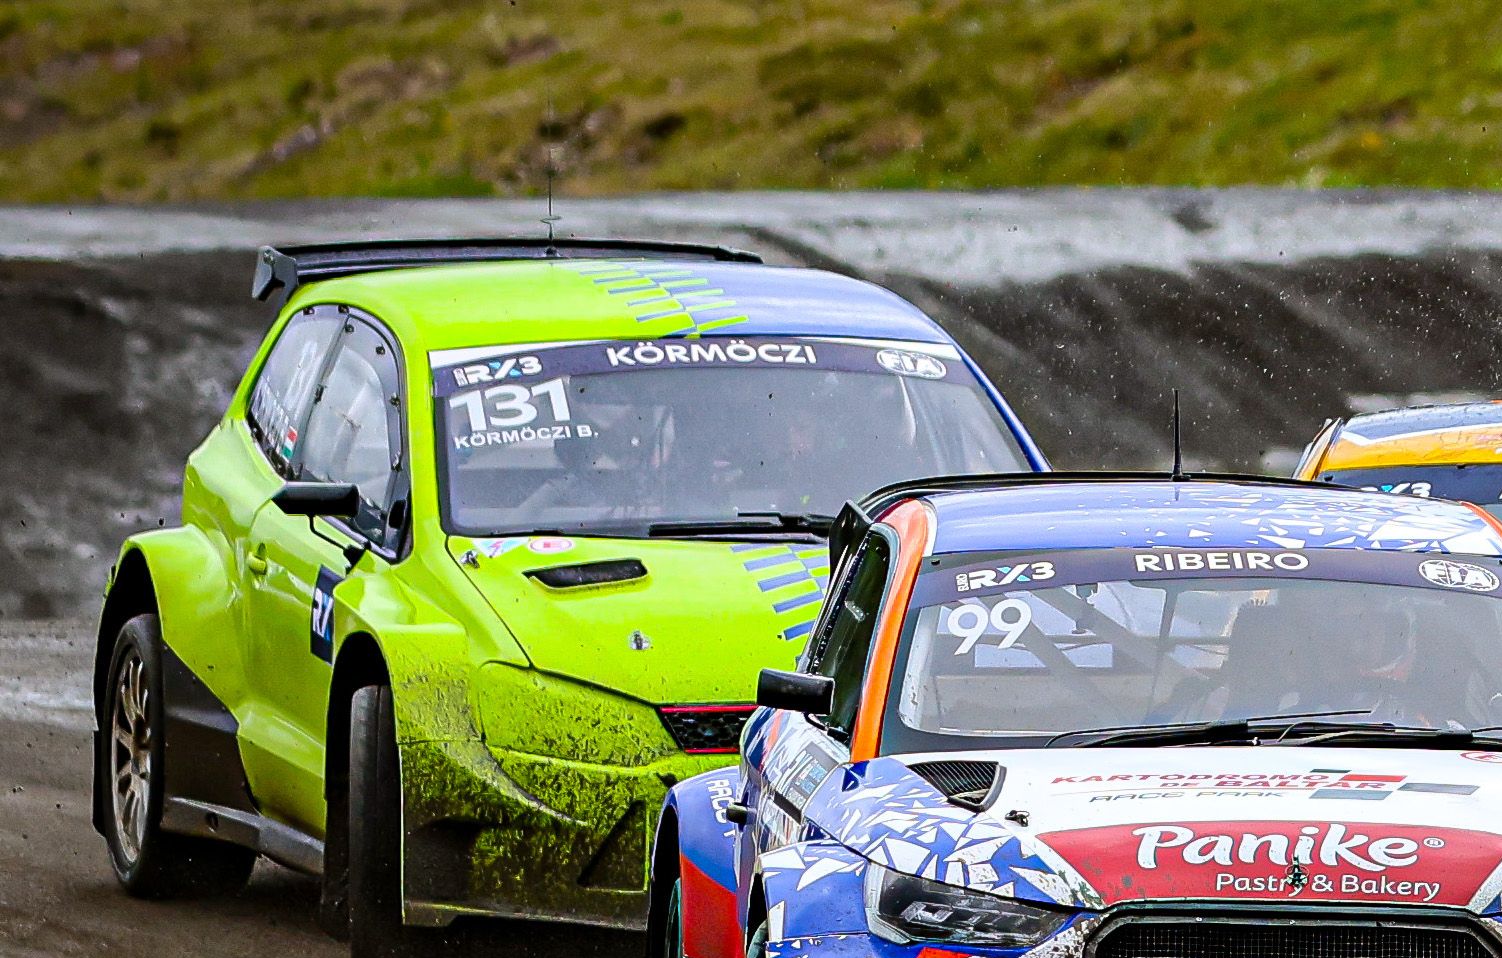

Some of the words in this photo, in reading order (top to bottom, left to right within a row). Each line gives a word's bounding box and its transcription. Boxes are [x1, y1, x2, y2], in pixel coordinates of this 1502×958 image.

[607, 340, 818, 367] KÖRMÖCZI
[879, 350, 944, 379] FIA
[450, 377, 571, 432] 131
[455, 425, 572, 450] KÖRMÖCZI
[576, 424, 599, 439] B.
[970, 562, 1056, 590] RX3
[1135, 552, 1309, 573] RIBEIRO
[1421, 561, 1496, 590] FIA
[947, 598, 1032, 656] 99
[1089, 791, 1186, 803] RACE
[1214, 780, 1387, 789] BALTAR
[1311, 874, 1334, 892] &
[1341, 874, 1440, 902] Bakery
